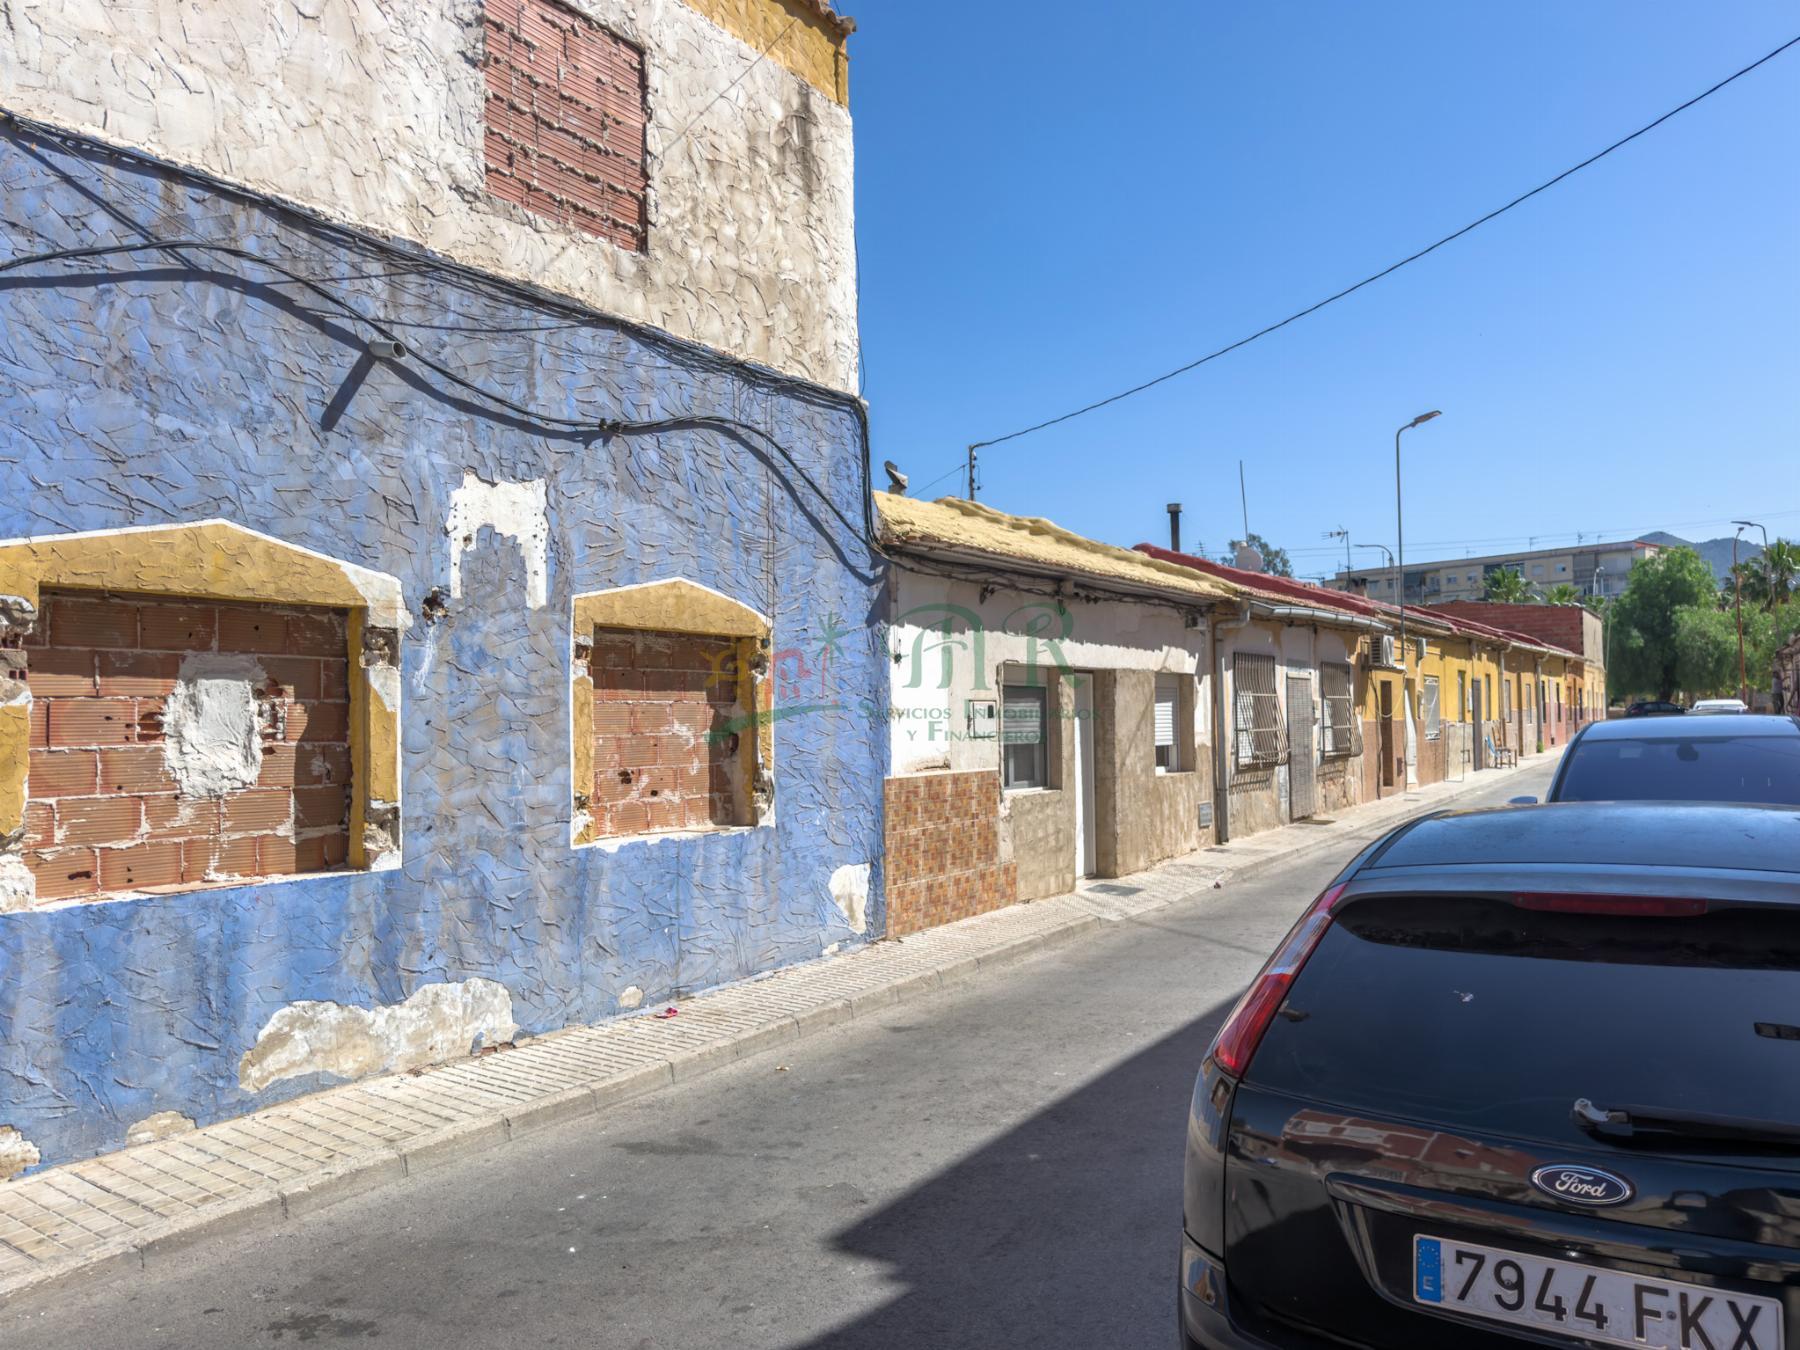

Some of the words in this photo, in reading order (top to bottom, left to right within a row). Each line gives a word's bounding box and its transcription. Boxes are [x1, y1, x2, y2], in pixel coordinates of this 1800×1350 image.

[1555, 1172, 1607, 1197] Ford
[1423, 1276, 1434, 1291] E
[1455, 1249, 1609, 1330] 7944
[1634, 1283, 1762, 1350] FKX
